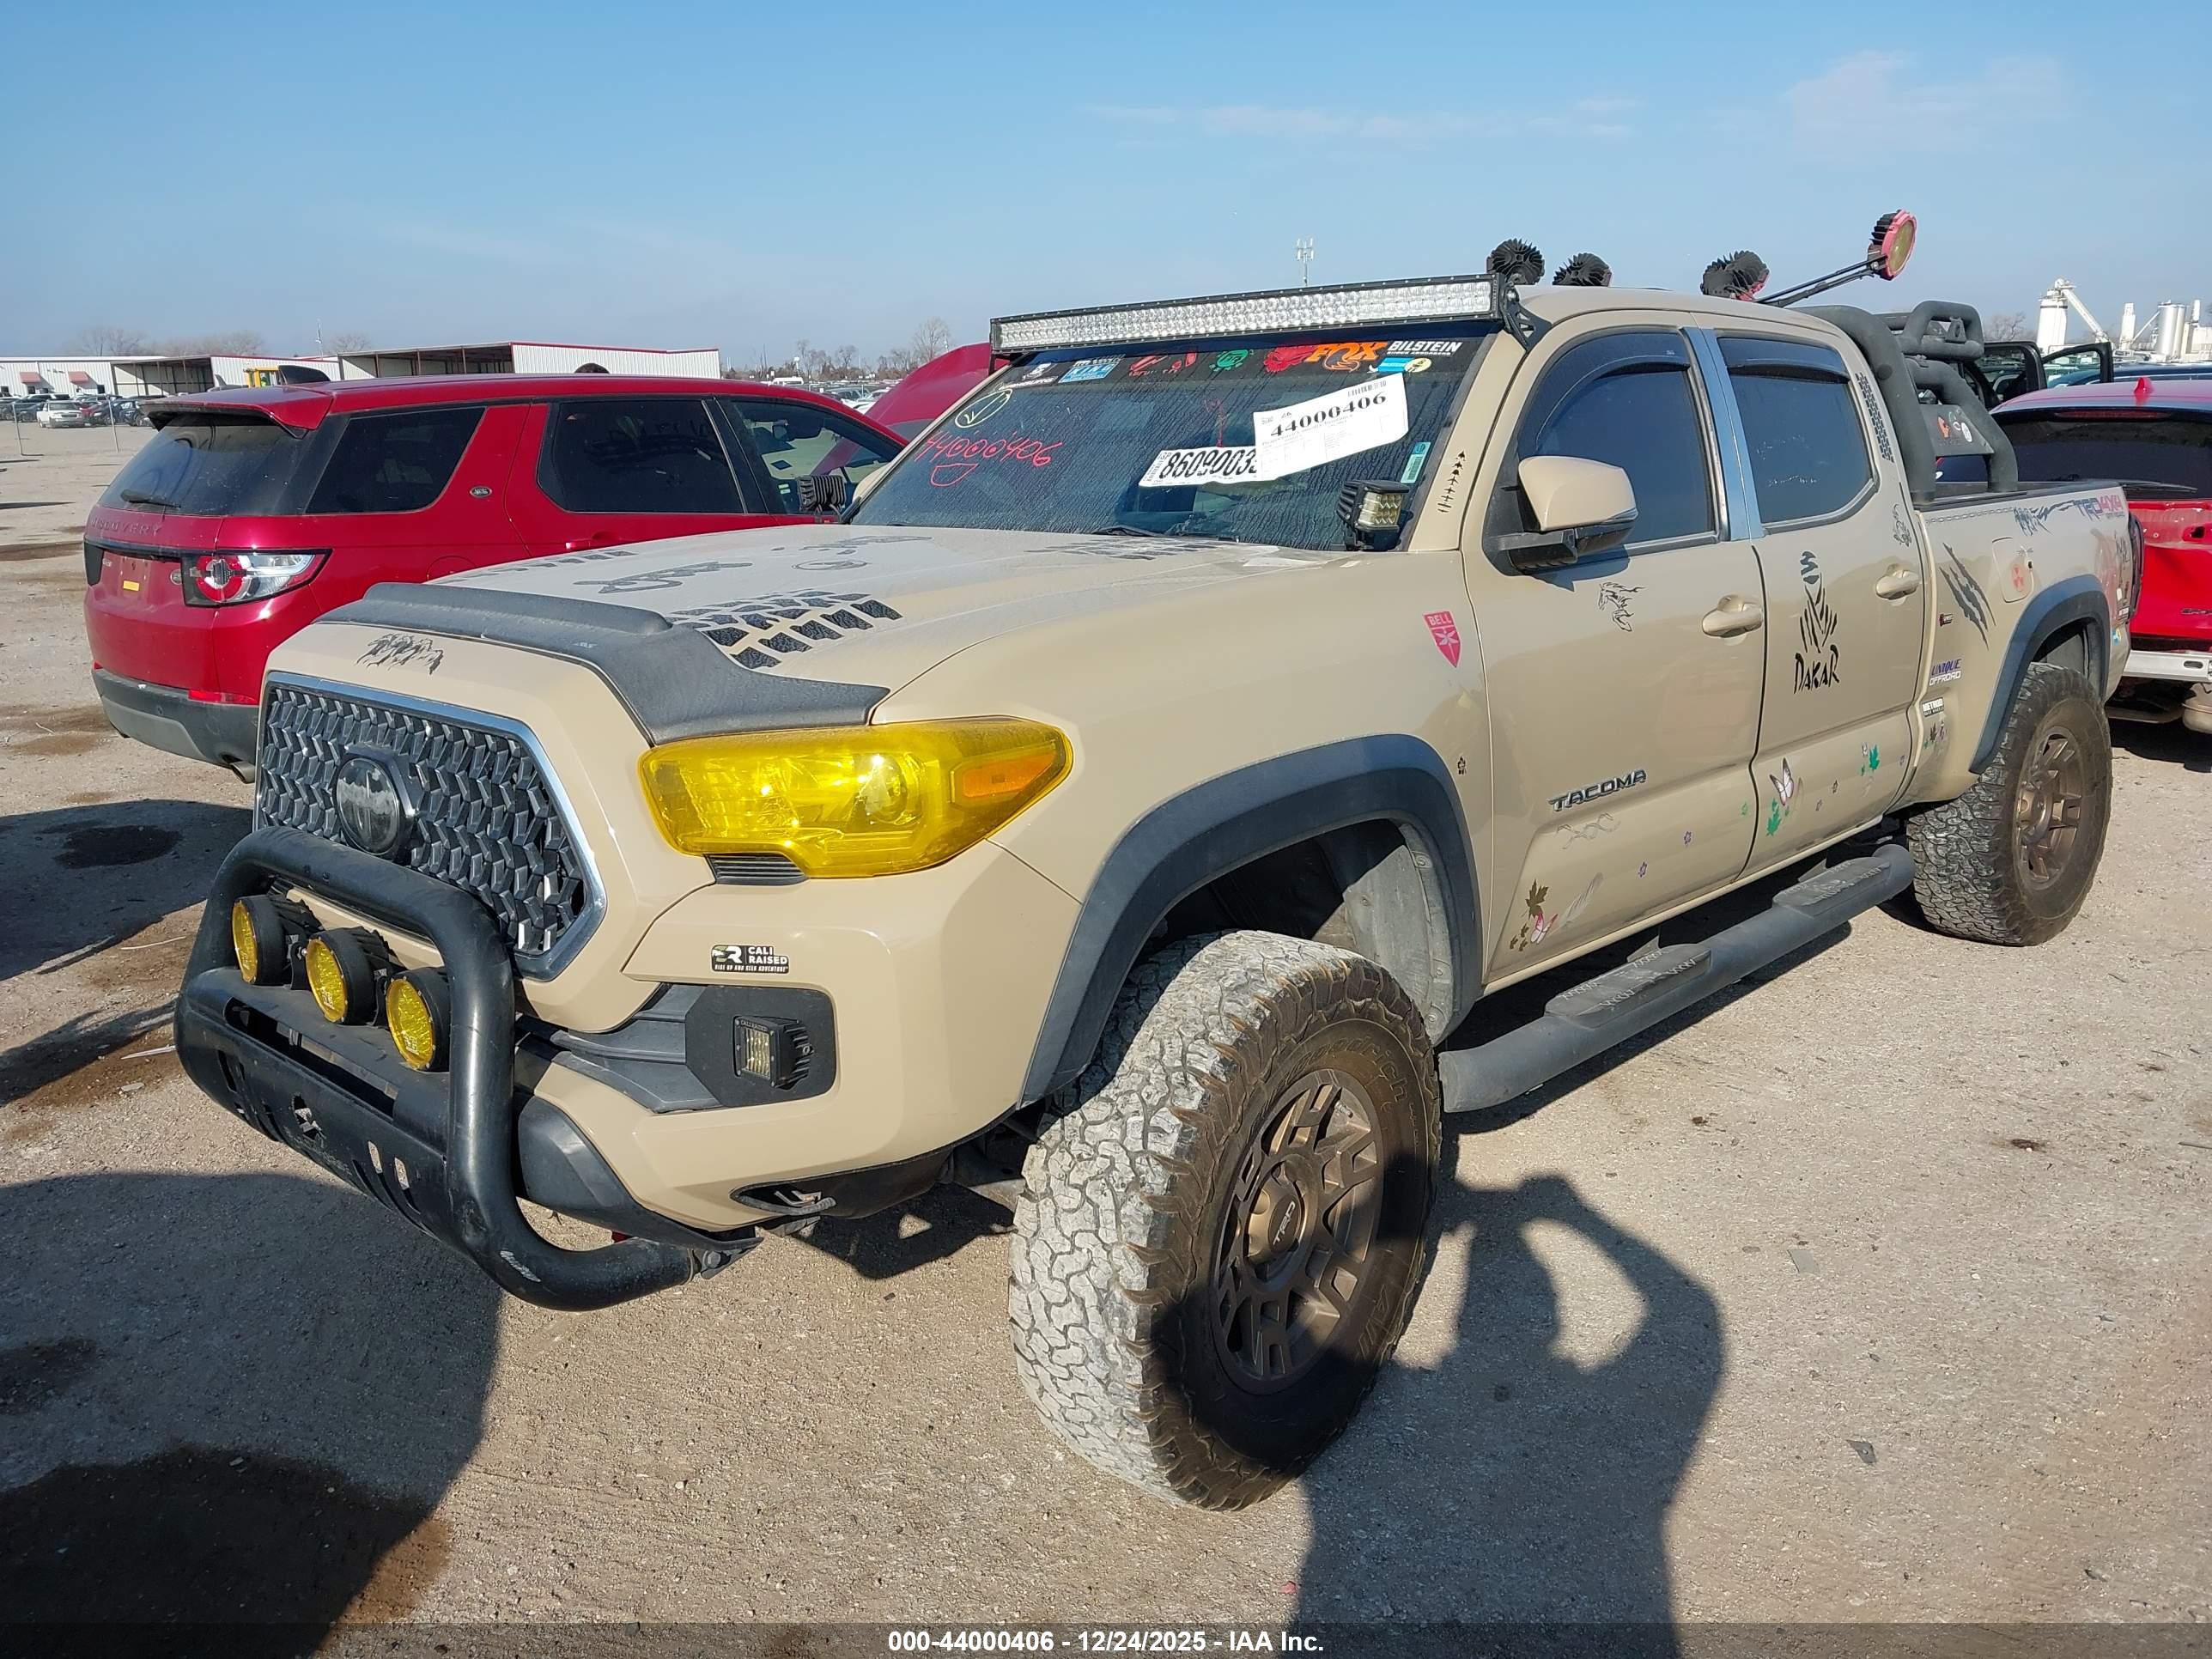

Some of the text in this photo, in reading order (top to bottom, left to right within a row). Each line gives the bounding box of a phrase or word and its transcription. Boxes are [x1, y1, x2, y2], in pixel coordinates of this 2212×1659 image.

[1304, 342, 1388, 364] FOX
[1387, 340, 1463, 352] BILSTEIN
[1270, 392, 1387, 437] 44000406
[914, 431, 1063, 467] 44000406
[1426, 613, 1453, 626] BELL
[1793, 644, 1840, 694] DAKAR
[1929, 670, 1961, 686] OFFROAD
[1932, 659, 1962, 677] UNIQUE
[1547, 769, 1647, 811] TACOMA
[748, 956, 788, 964] RAISED
[1273, 1200, 1296, 1245] TRD
